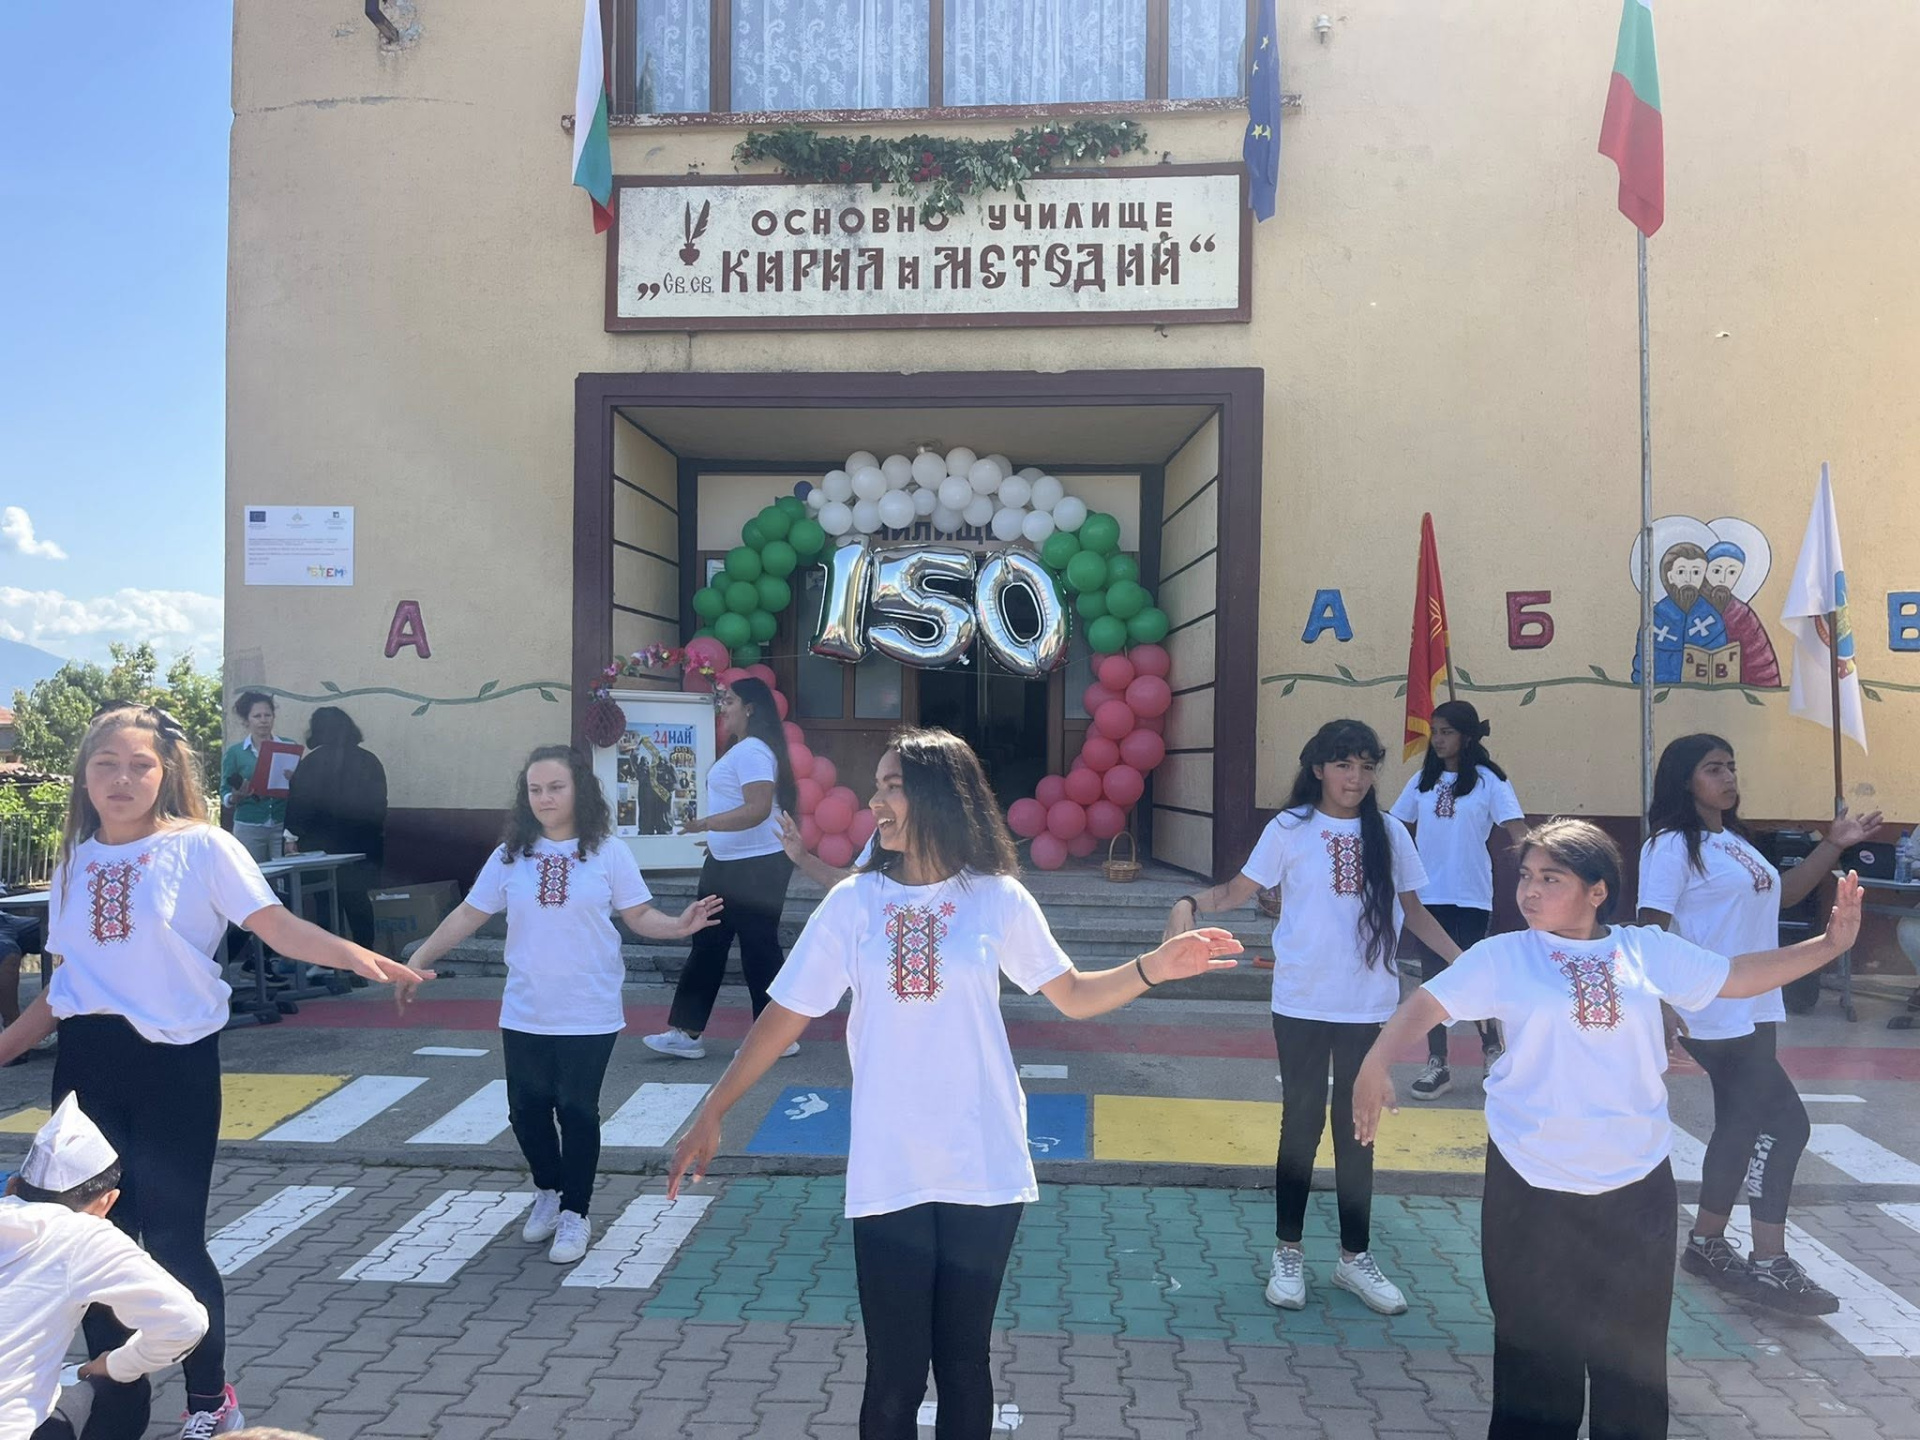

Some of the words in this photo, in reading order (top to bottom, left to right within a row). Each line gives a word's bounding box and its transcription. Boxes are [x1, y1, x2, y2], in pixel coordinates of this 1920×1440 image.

[751, 206, 951, 236] ОСНОВНО
[988, 201, 1172, 232] УЧИЛИЩЕ
[808, 534, 1073, 679] 150
[1506, 590, 1555, 650] Б
